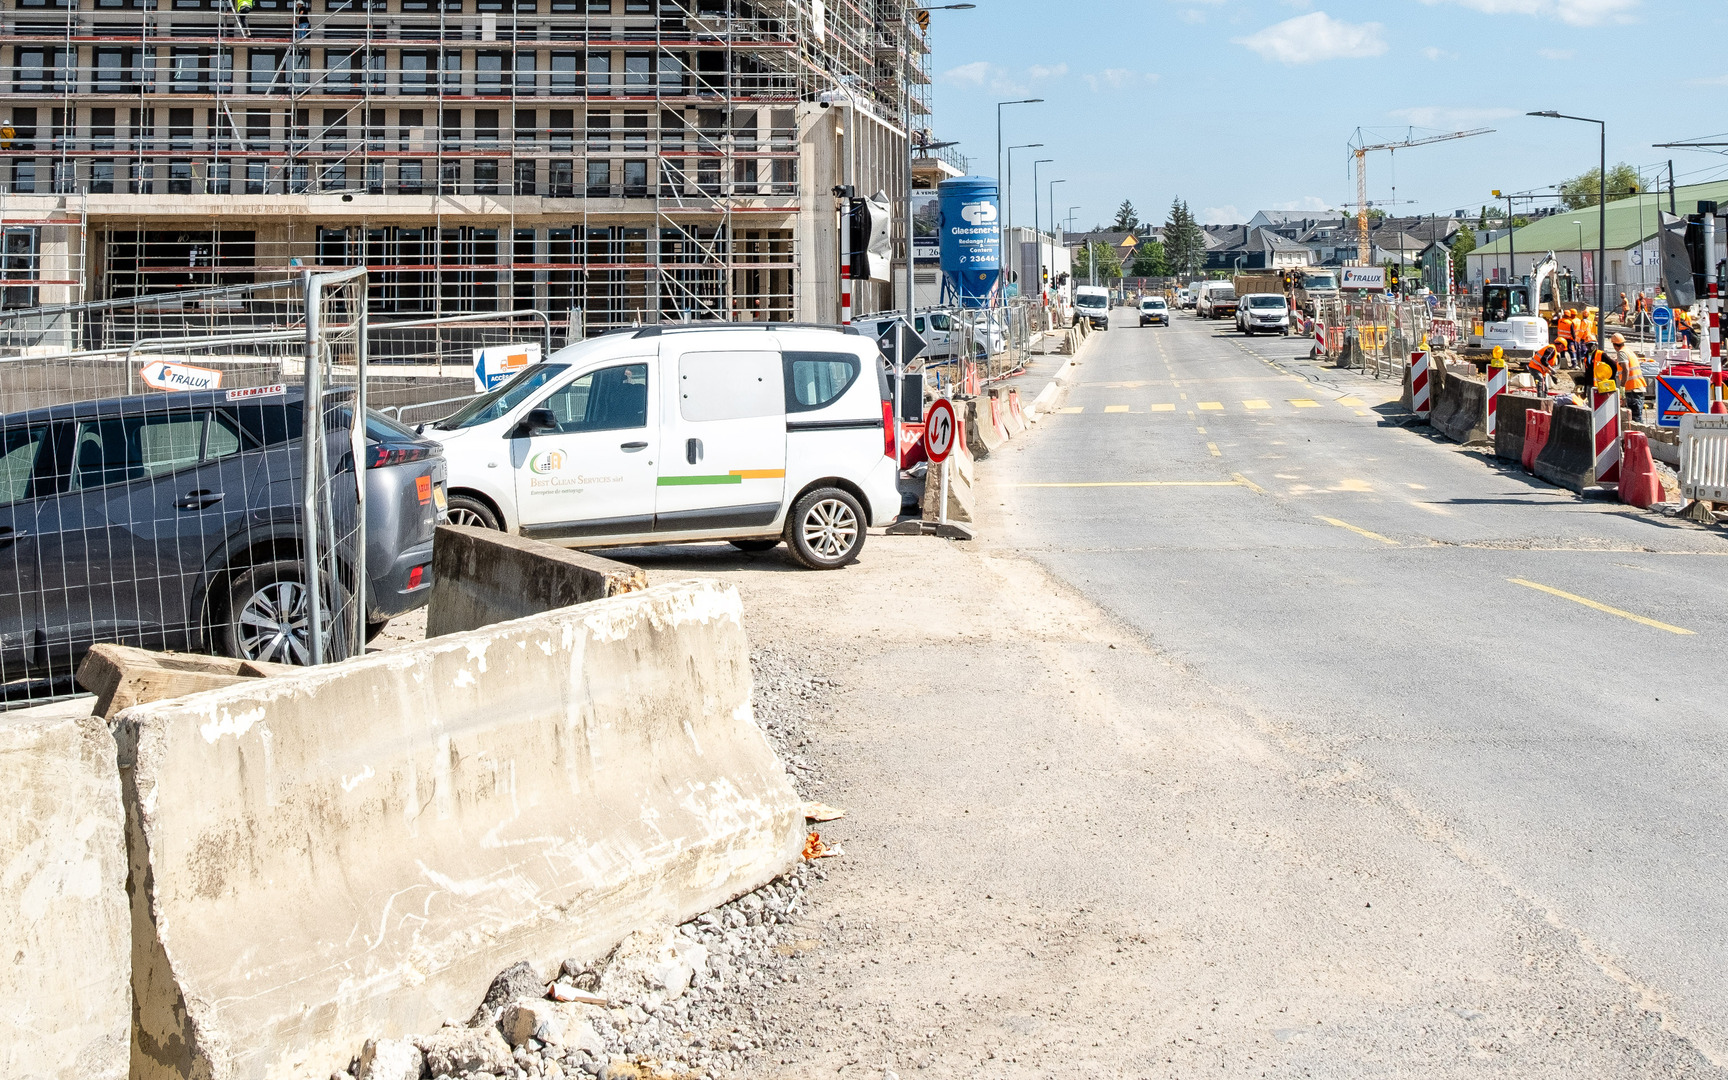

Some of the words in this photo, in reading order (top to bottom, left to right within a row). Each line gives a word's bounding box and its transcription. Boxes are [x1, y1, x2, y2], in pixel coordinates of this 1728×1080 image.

[1353, 274, 1381, 282] TRALUX
[170, 373, 211, 389] TRALUX
[230, 385, 282, 398] SERMATEC
